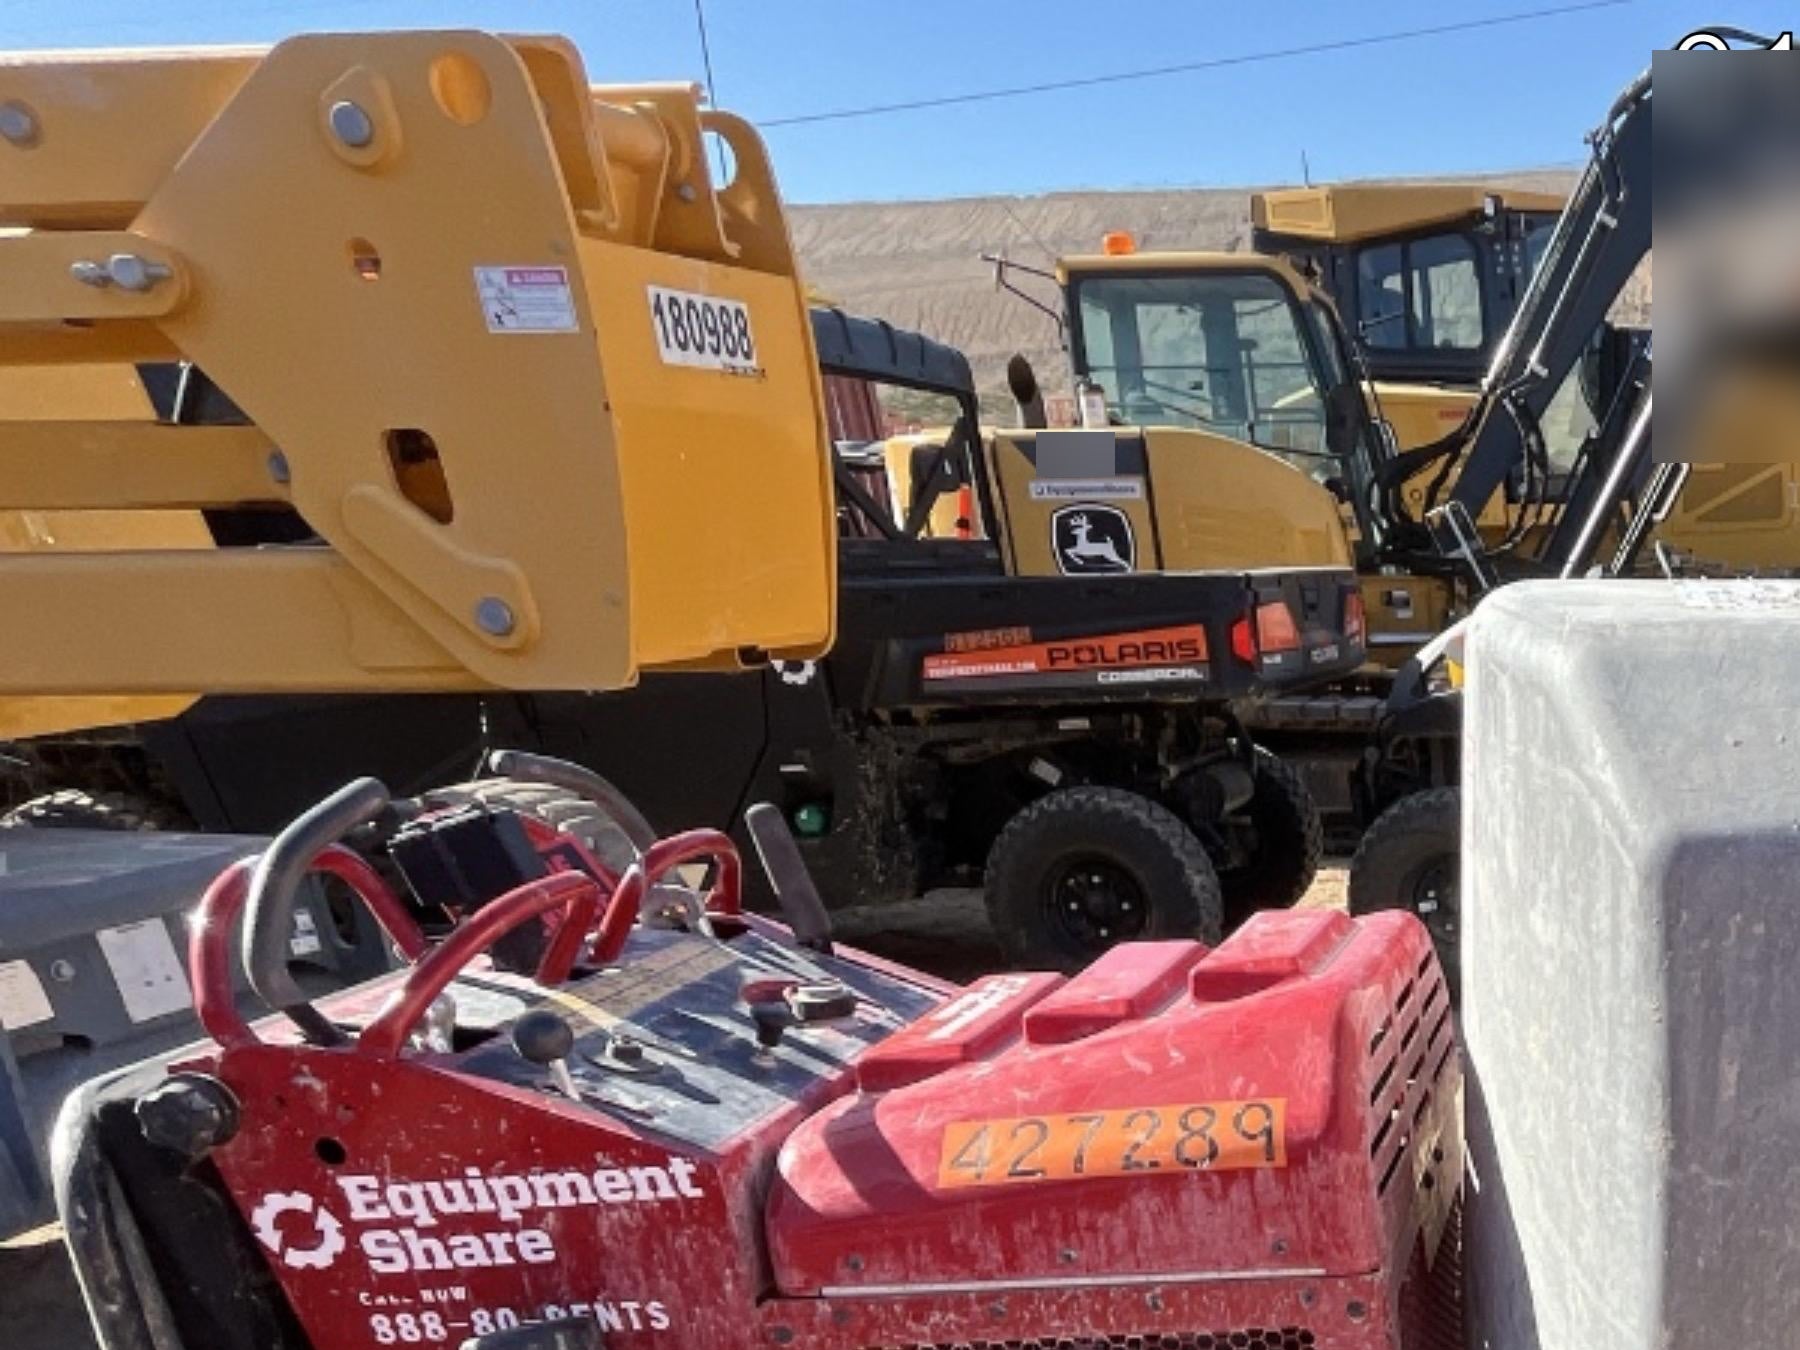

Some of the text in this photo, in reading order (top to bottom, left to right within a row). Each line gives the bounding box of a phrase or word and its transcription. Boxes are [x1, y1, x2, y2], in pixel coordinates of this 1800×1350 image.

[653, 292, 754, 361] 180988
[1046, 639, 1202, 667] POLARIS
[948, 1101, 1276, 1180] 427289
[336, 1156, 703, 1227] Equipment
[359, 1228, 556, 1273] Share
